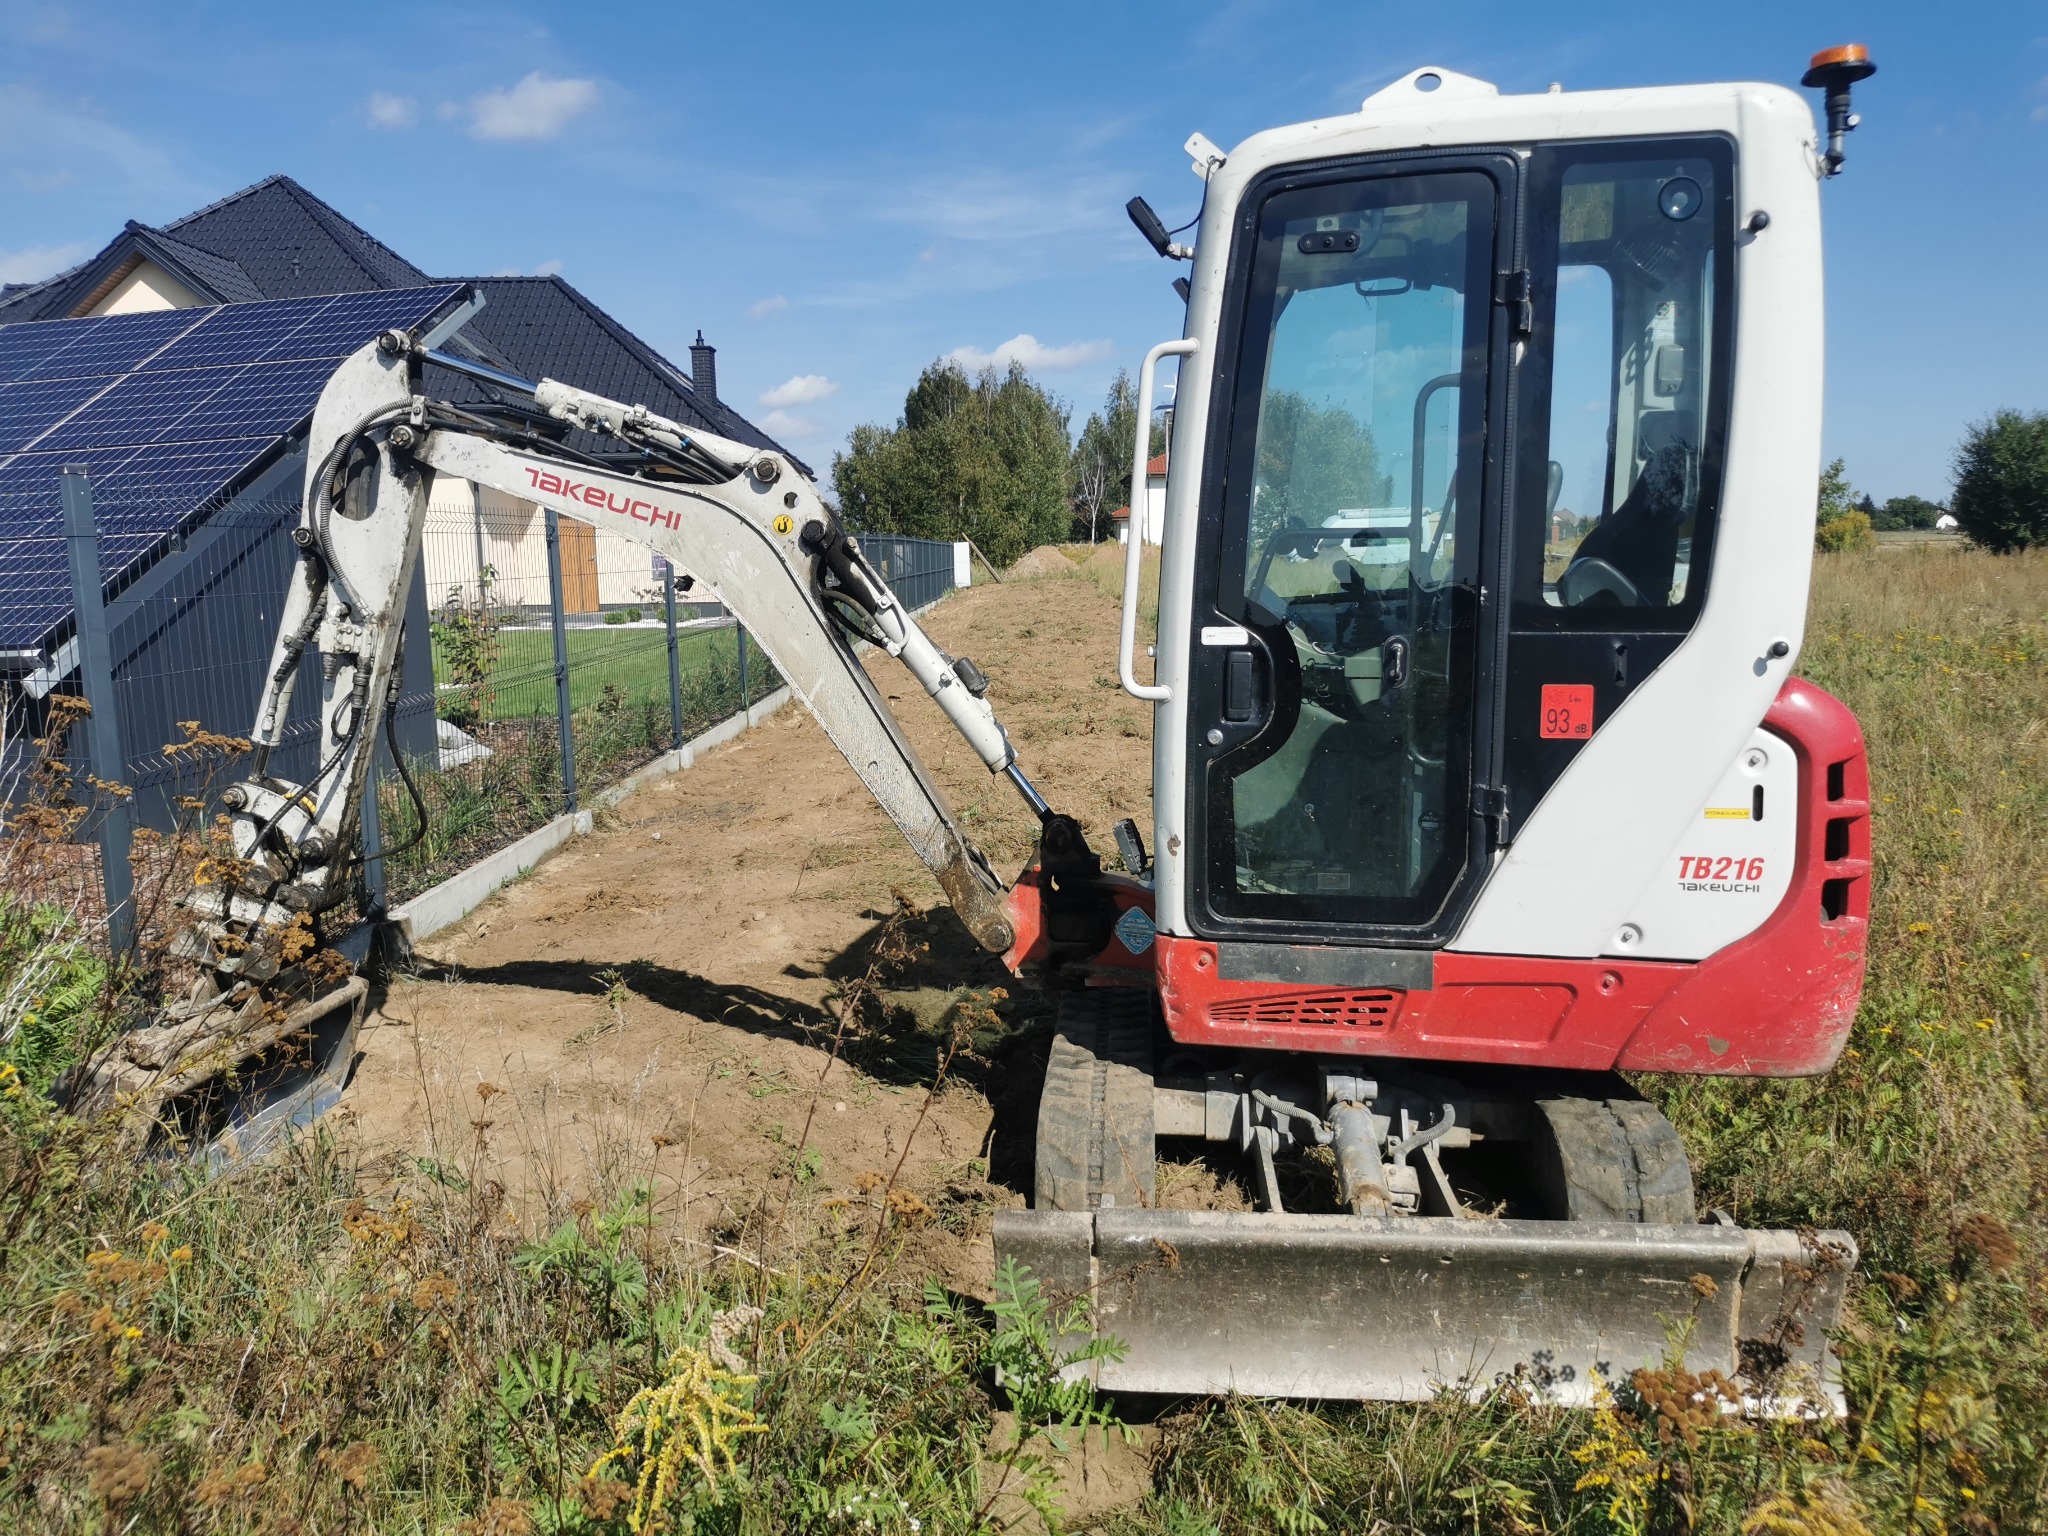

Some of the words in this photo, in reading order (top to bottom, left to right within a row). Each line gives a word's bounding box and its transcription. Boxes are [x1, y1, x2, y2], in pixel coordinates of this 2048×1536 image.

[1546, 708, 1570, 734] 93
[1575, 723, 1588, 734] dB
[1679, 856, 1765, 881] TB216
